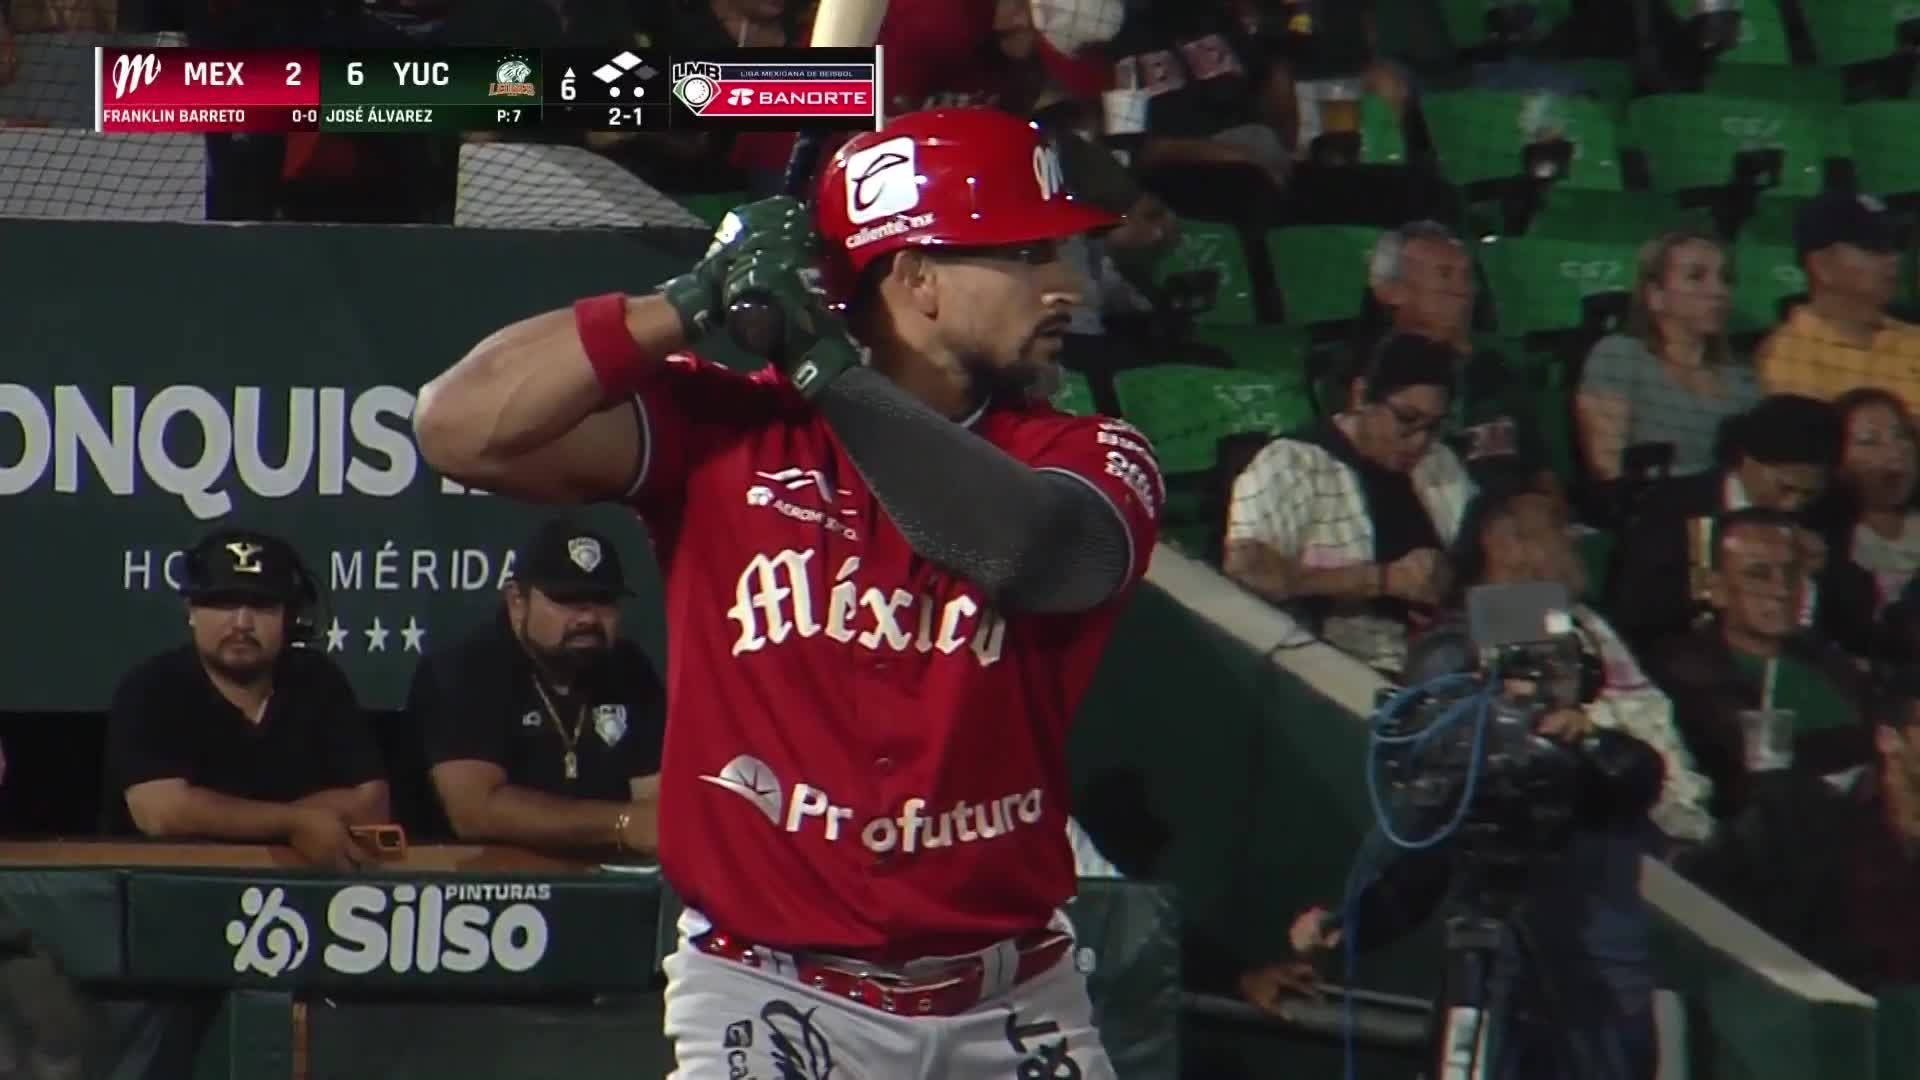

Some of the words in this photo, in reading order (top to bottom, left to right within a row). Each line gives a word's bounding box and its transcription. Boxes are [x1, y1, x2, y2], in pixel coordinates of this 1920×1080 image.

[727, 548, 1006, 667] México
[323, 885, 549, 975] Silso
[445, 883, 552, 901] PINTURAS
